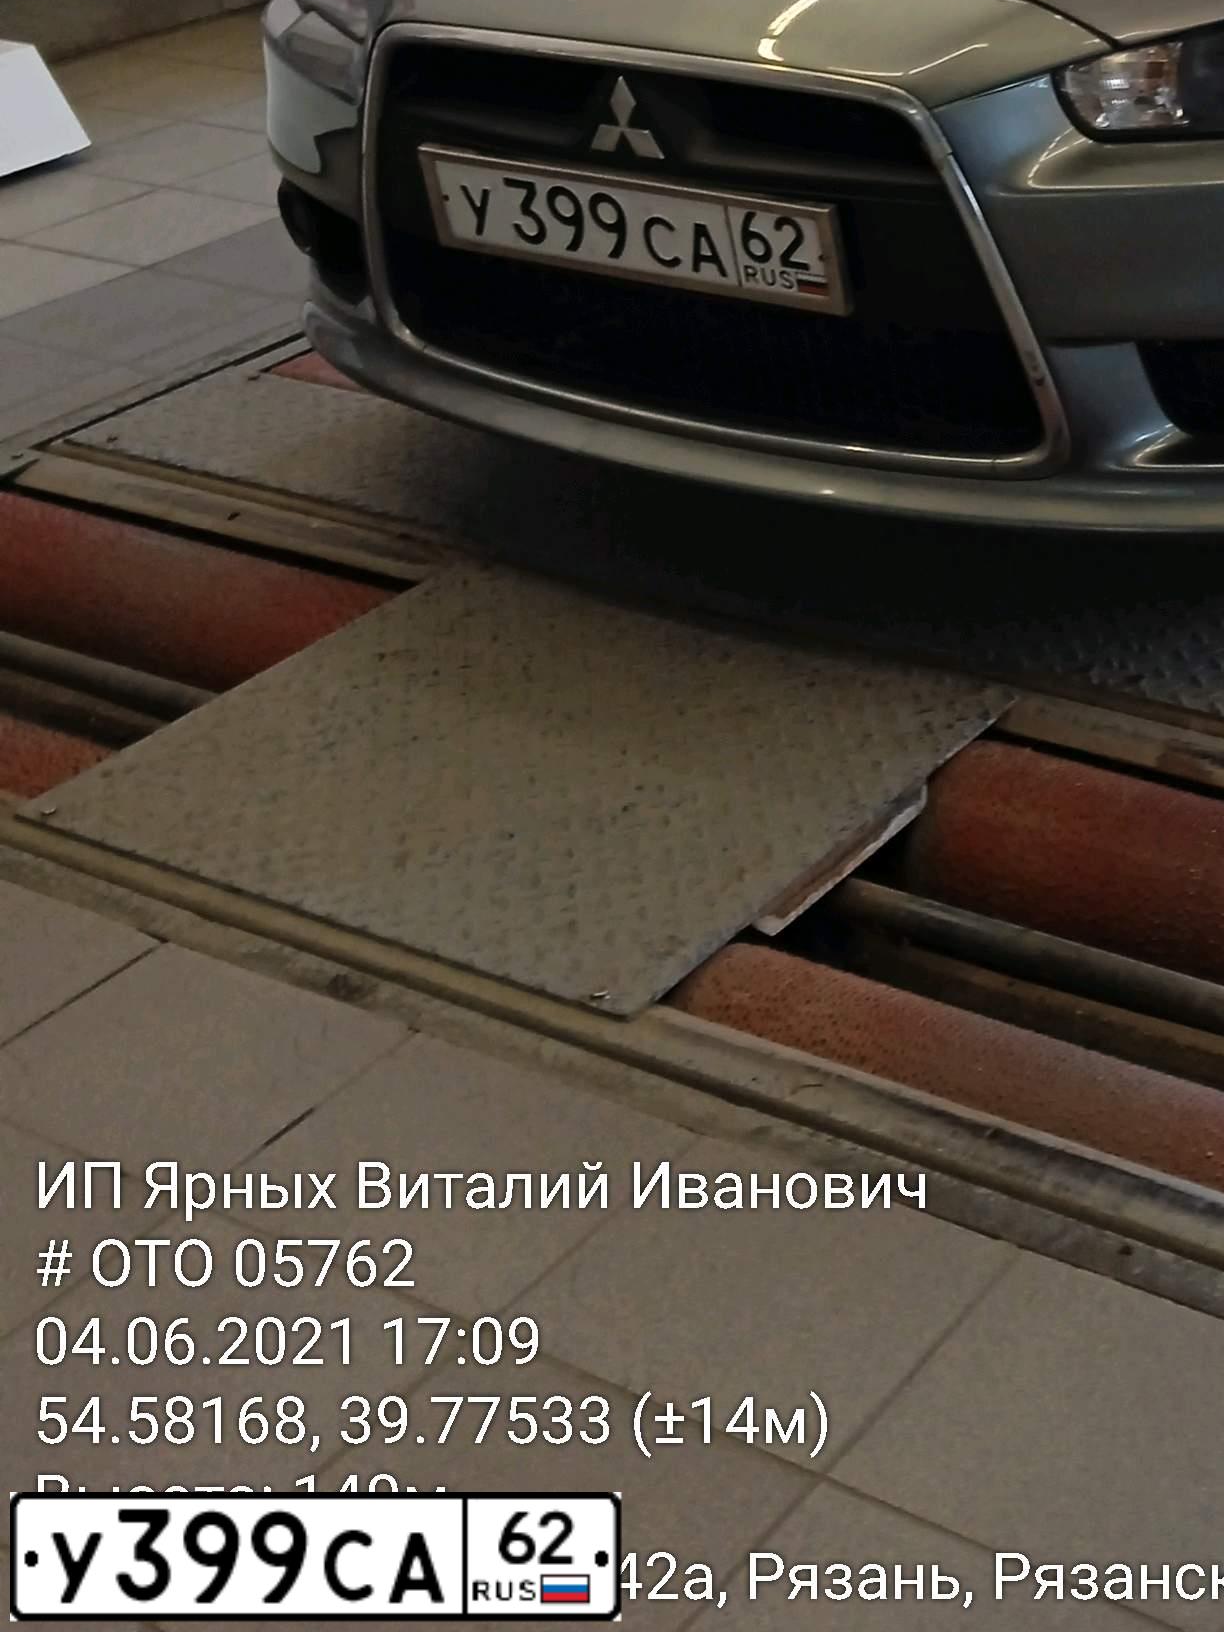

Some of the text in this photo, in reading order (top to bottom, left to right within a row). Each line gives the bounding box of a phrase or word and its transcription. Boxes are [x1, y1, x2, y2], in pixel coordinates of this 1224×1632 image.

[460, 177, 810, 279] У399СА 62
[743, 264, 796, 291] RUS
